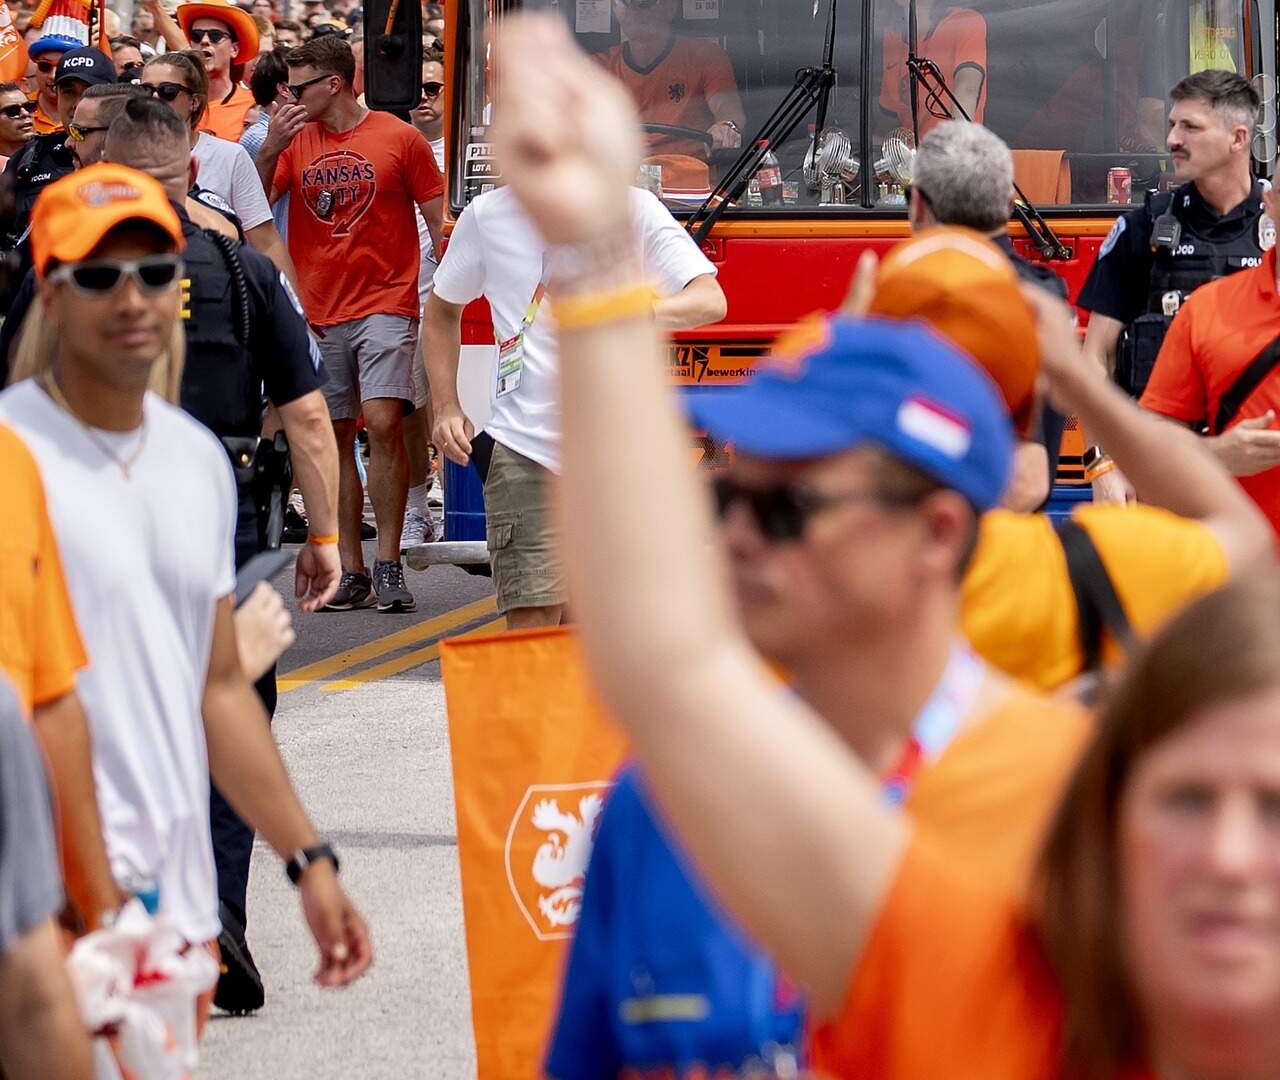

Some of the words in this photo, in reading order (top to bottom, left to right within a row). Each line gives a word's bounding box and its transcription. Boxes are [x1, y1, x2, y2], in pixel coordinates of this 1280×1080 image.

[63, 56, 95, 68] KCPD
[472, 164, 485, 172] LOT
[302, 163, 376, 186] KANSAS
